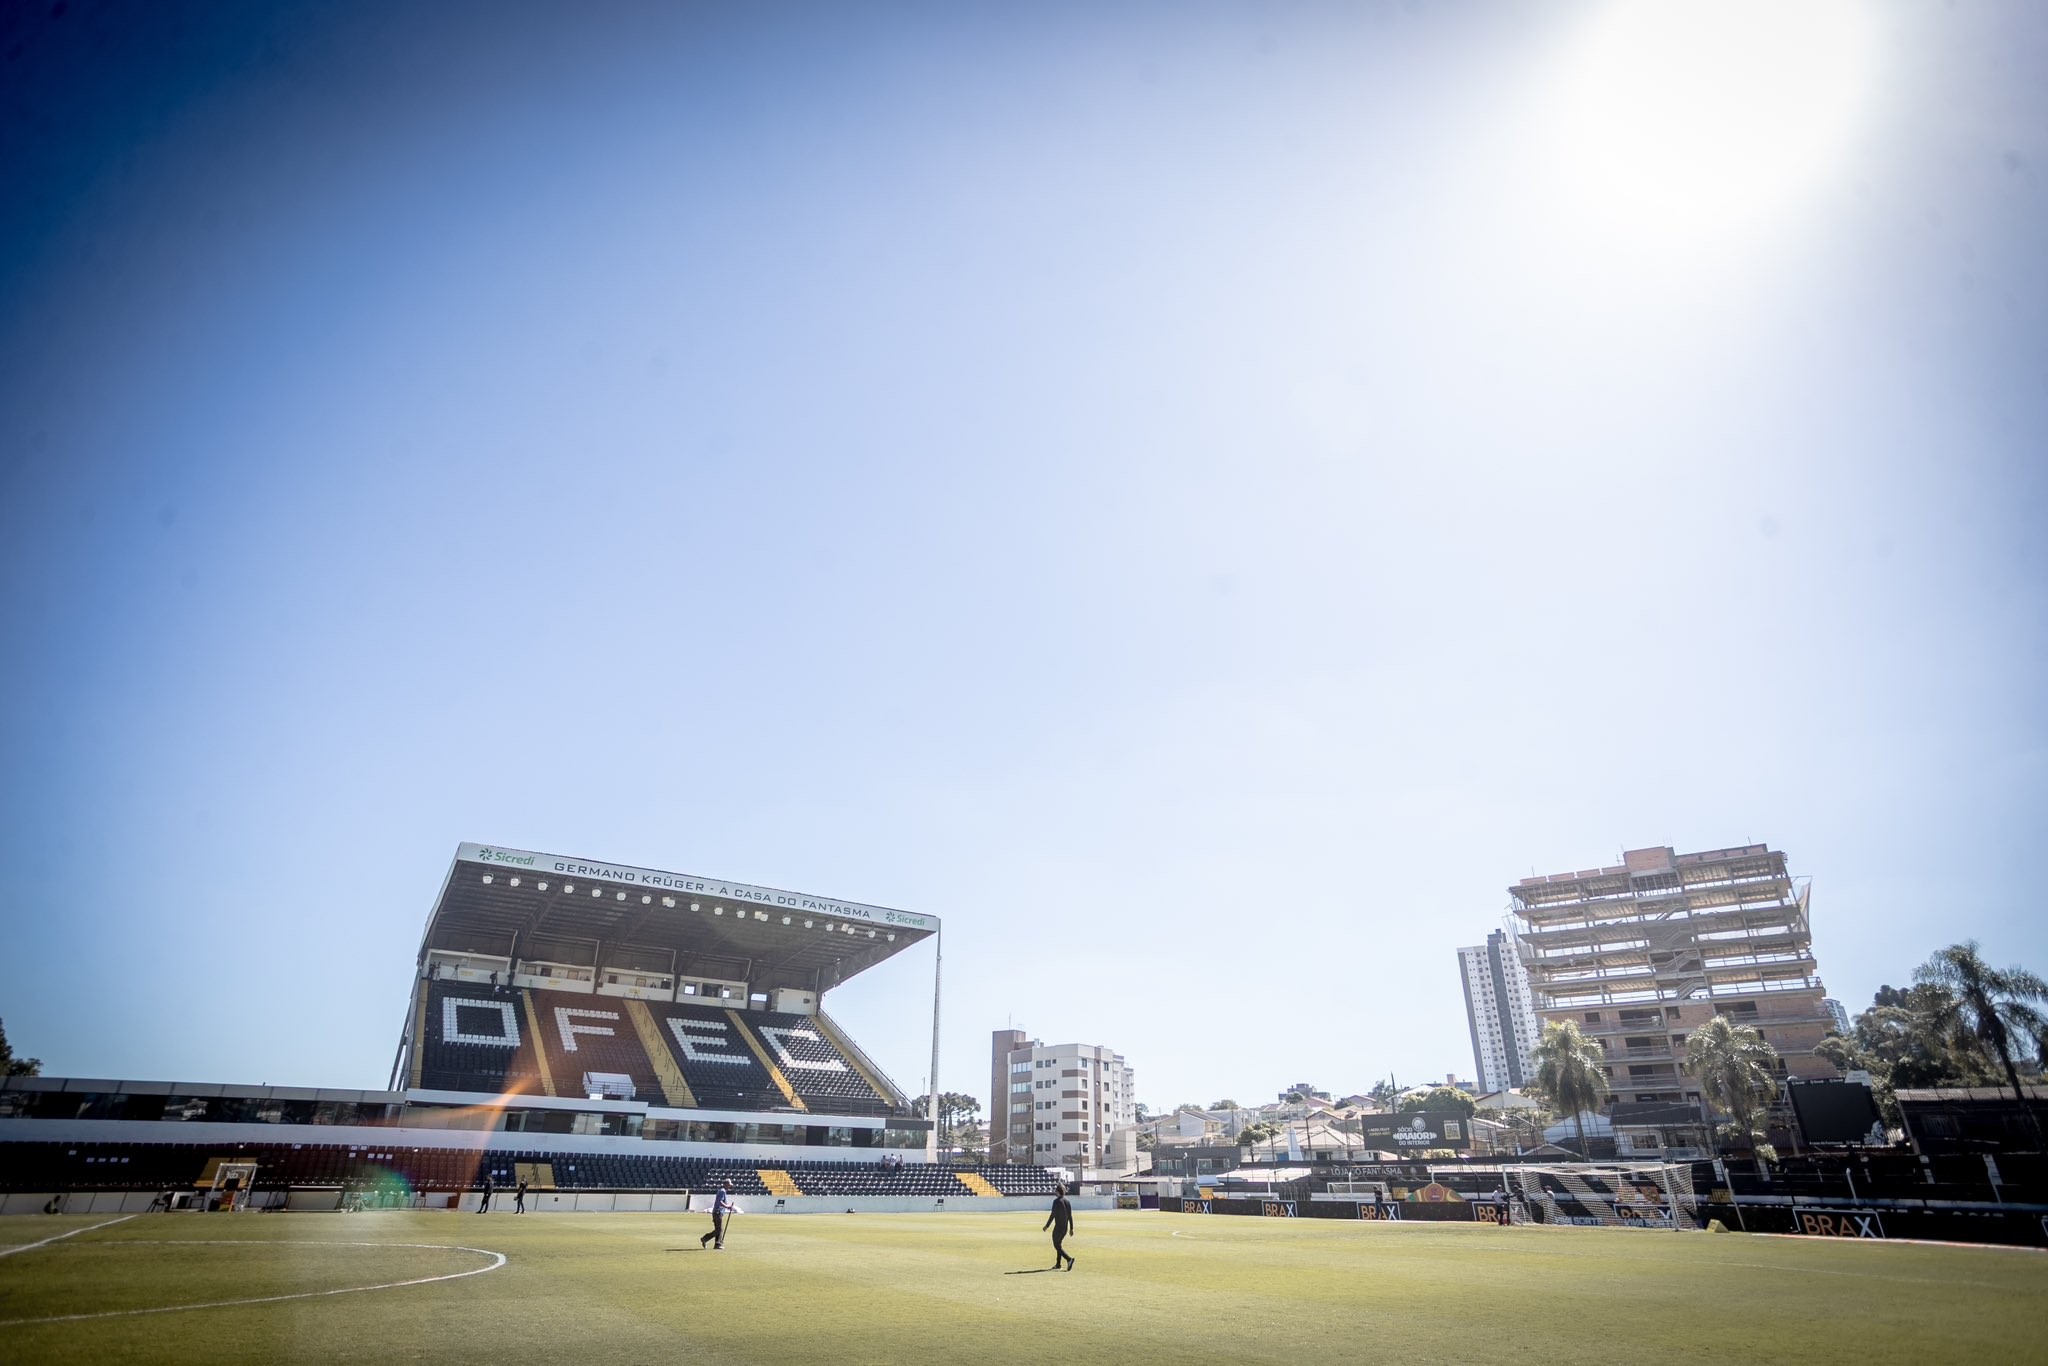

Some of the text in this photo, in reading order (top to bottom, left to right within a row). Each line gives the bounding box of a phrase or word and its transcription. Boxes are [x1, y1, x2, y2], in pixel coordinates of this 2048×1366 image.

[494, 851, 535, 867] Sicredi
[554, 862, 635, 882] GERMANO
[641, 874, 705, 892] KRÜGER
[719, 886, 728, 896] A
[734, 889, 771, 903] CASA
[777, 896, 797, 906] DO
[802, 899, 871, 919] FANTASMA
[896, 914, 925, 927] Sicredi
[442, 996, 849, 1072] OFEC
[1399, 1131, 1431, 1140] MAIOR
[1184, 1201, 1209, 1214] BRAX
[1265, 1203, 1295, 1217] BRAX
[1361, 1205, 1397, 1220] BRAX
[1802, 1214, 1877, 1238] BRAX
